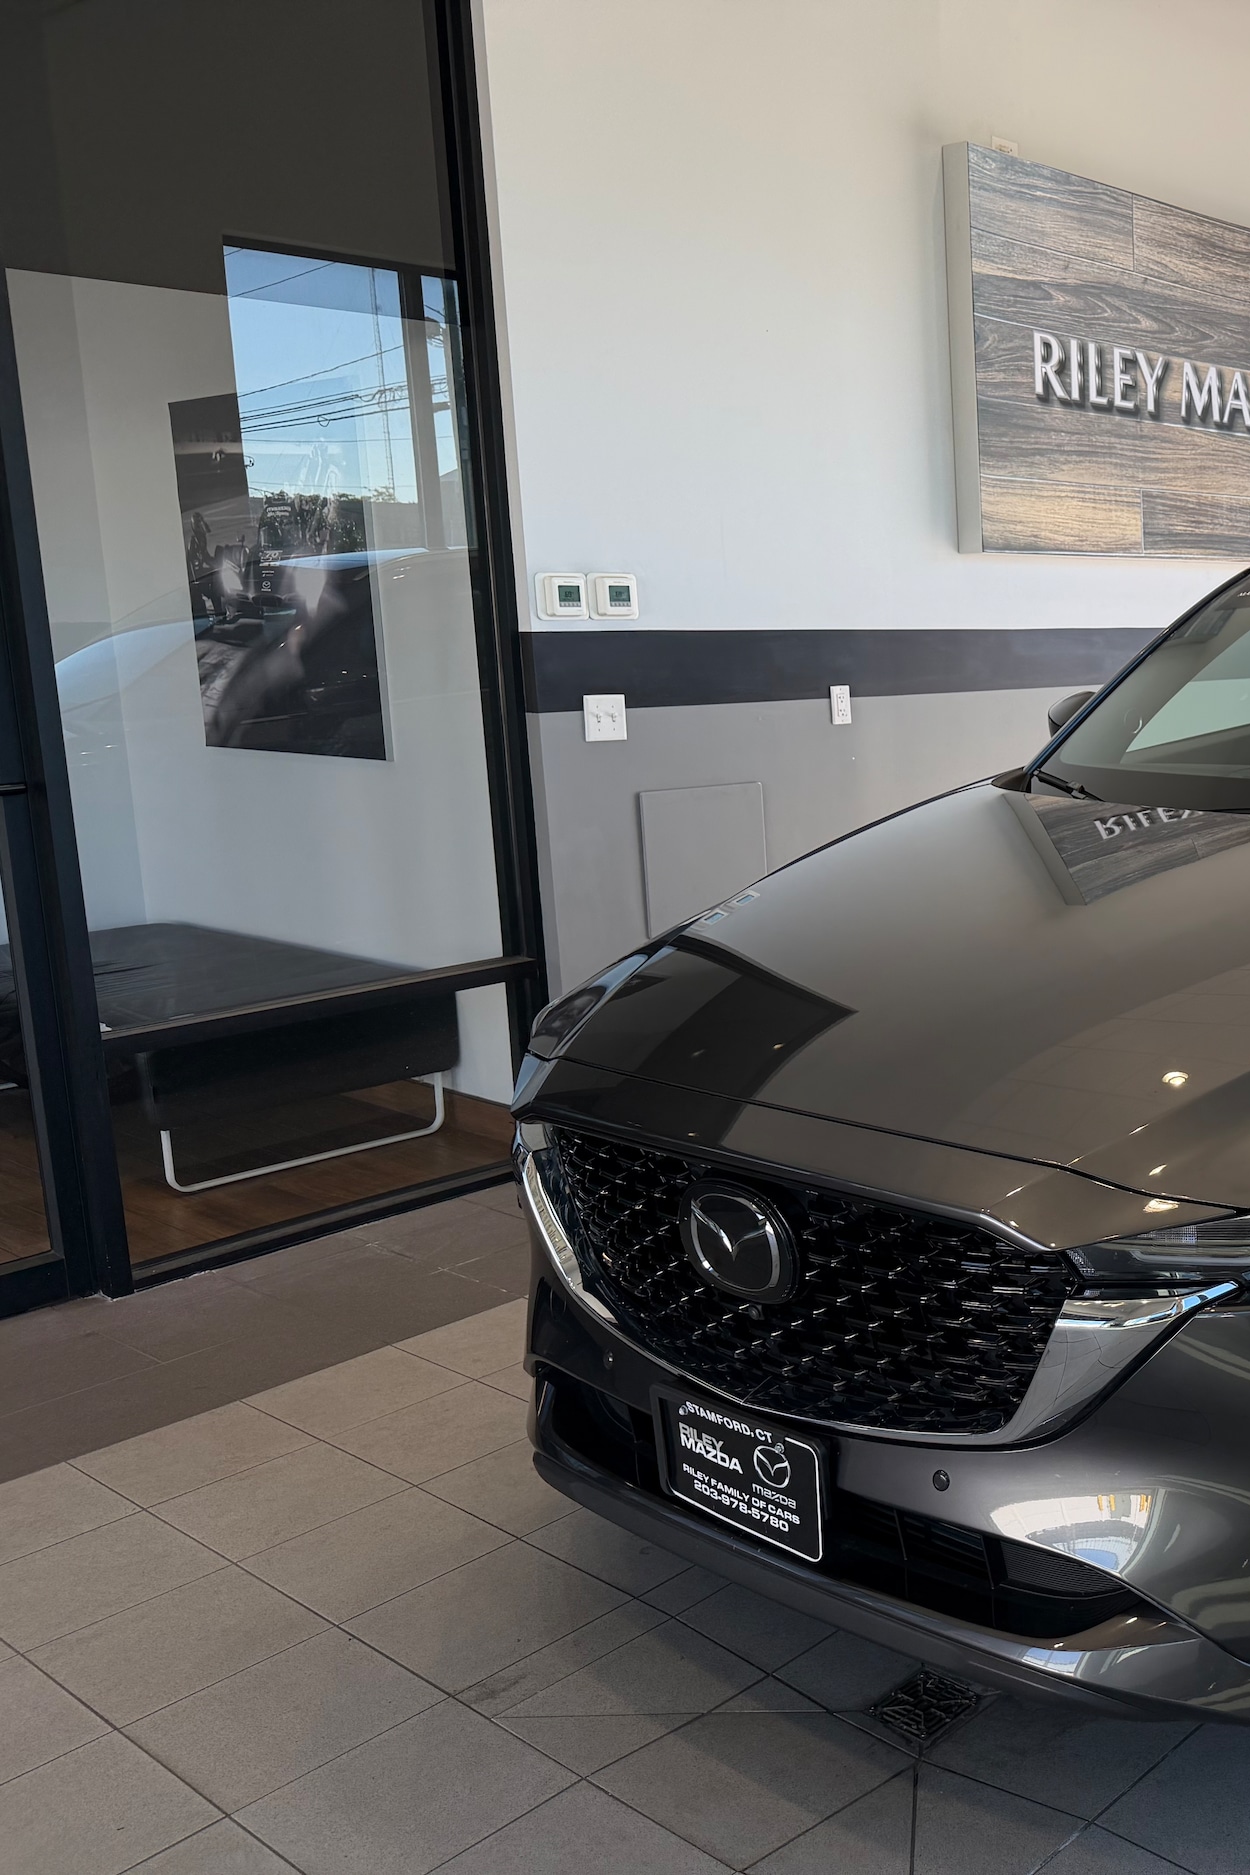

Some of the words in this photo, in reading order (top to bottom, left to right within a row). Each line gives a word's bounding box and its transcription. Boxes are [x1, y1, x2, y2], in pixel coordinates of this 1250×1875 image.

[1034, 330, 1168, 417] RILEY
[679, 1422, 723, 1452] RILEY
[686, 1401, 754, 1438] STAMFORD,
[756, 1429, 773, 1444] CT
[681, 1434, 743, 1474] MAZDA
[683, 1463, 709, 1483] RILEY
[711, 1478, 749, 1502] FAMILY
[752, 1497, 767, 1509] OF
[768, 1504, 800, 1525] CARS
[694, 1480, 789, 1532] 203-978-5780
[752, 1483, 797, 1510] mazda
